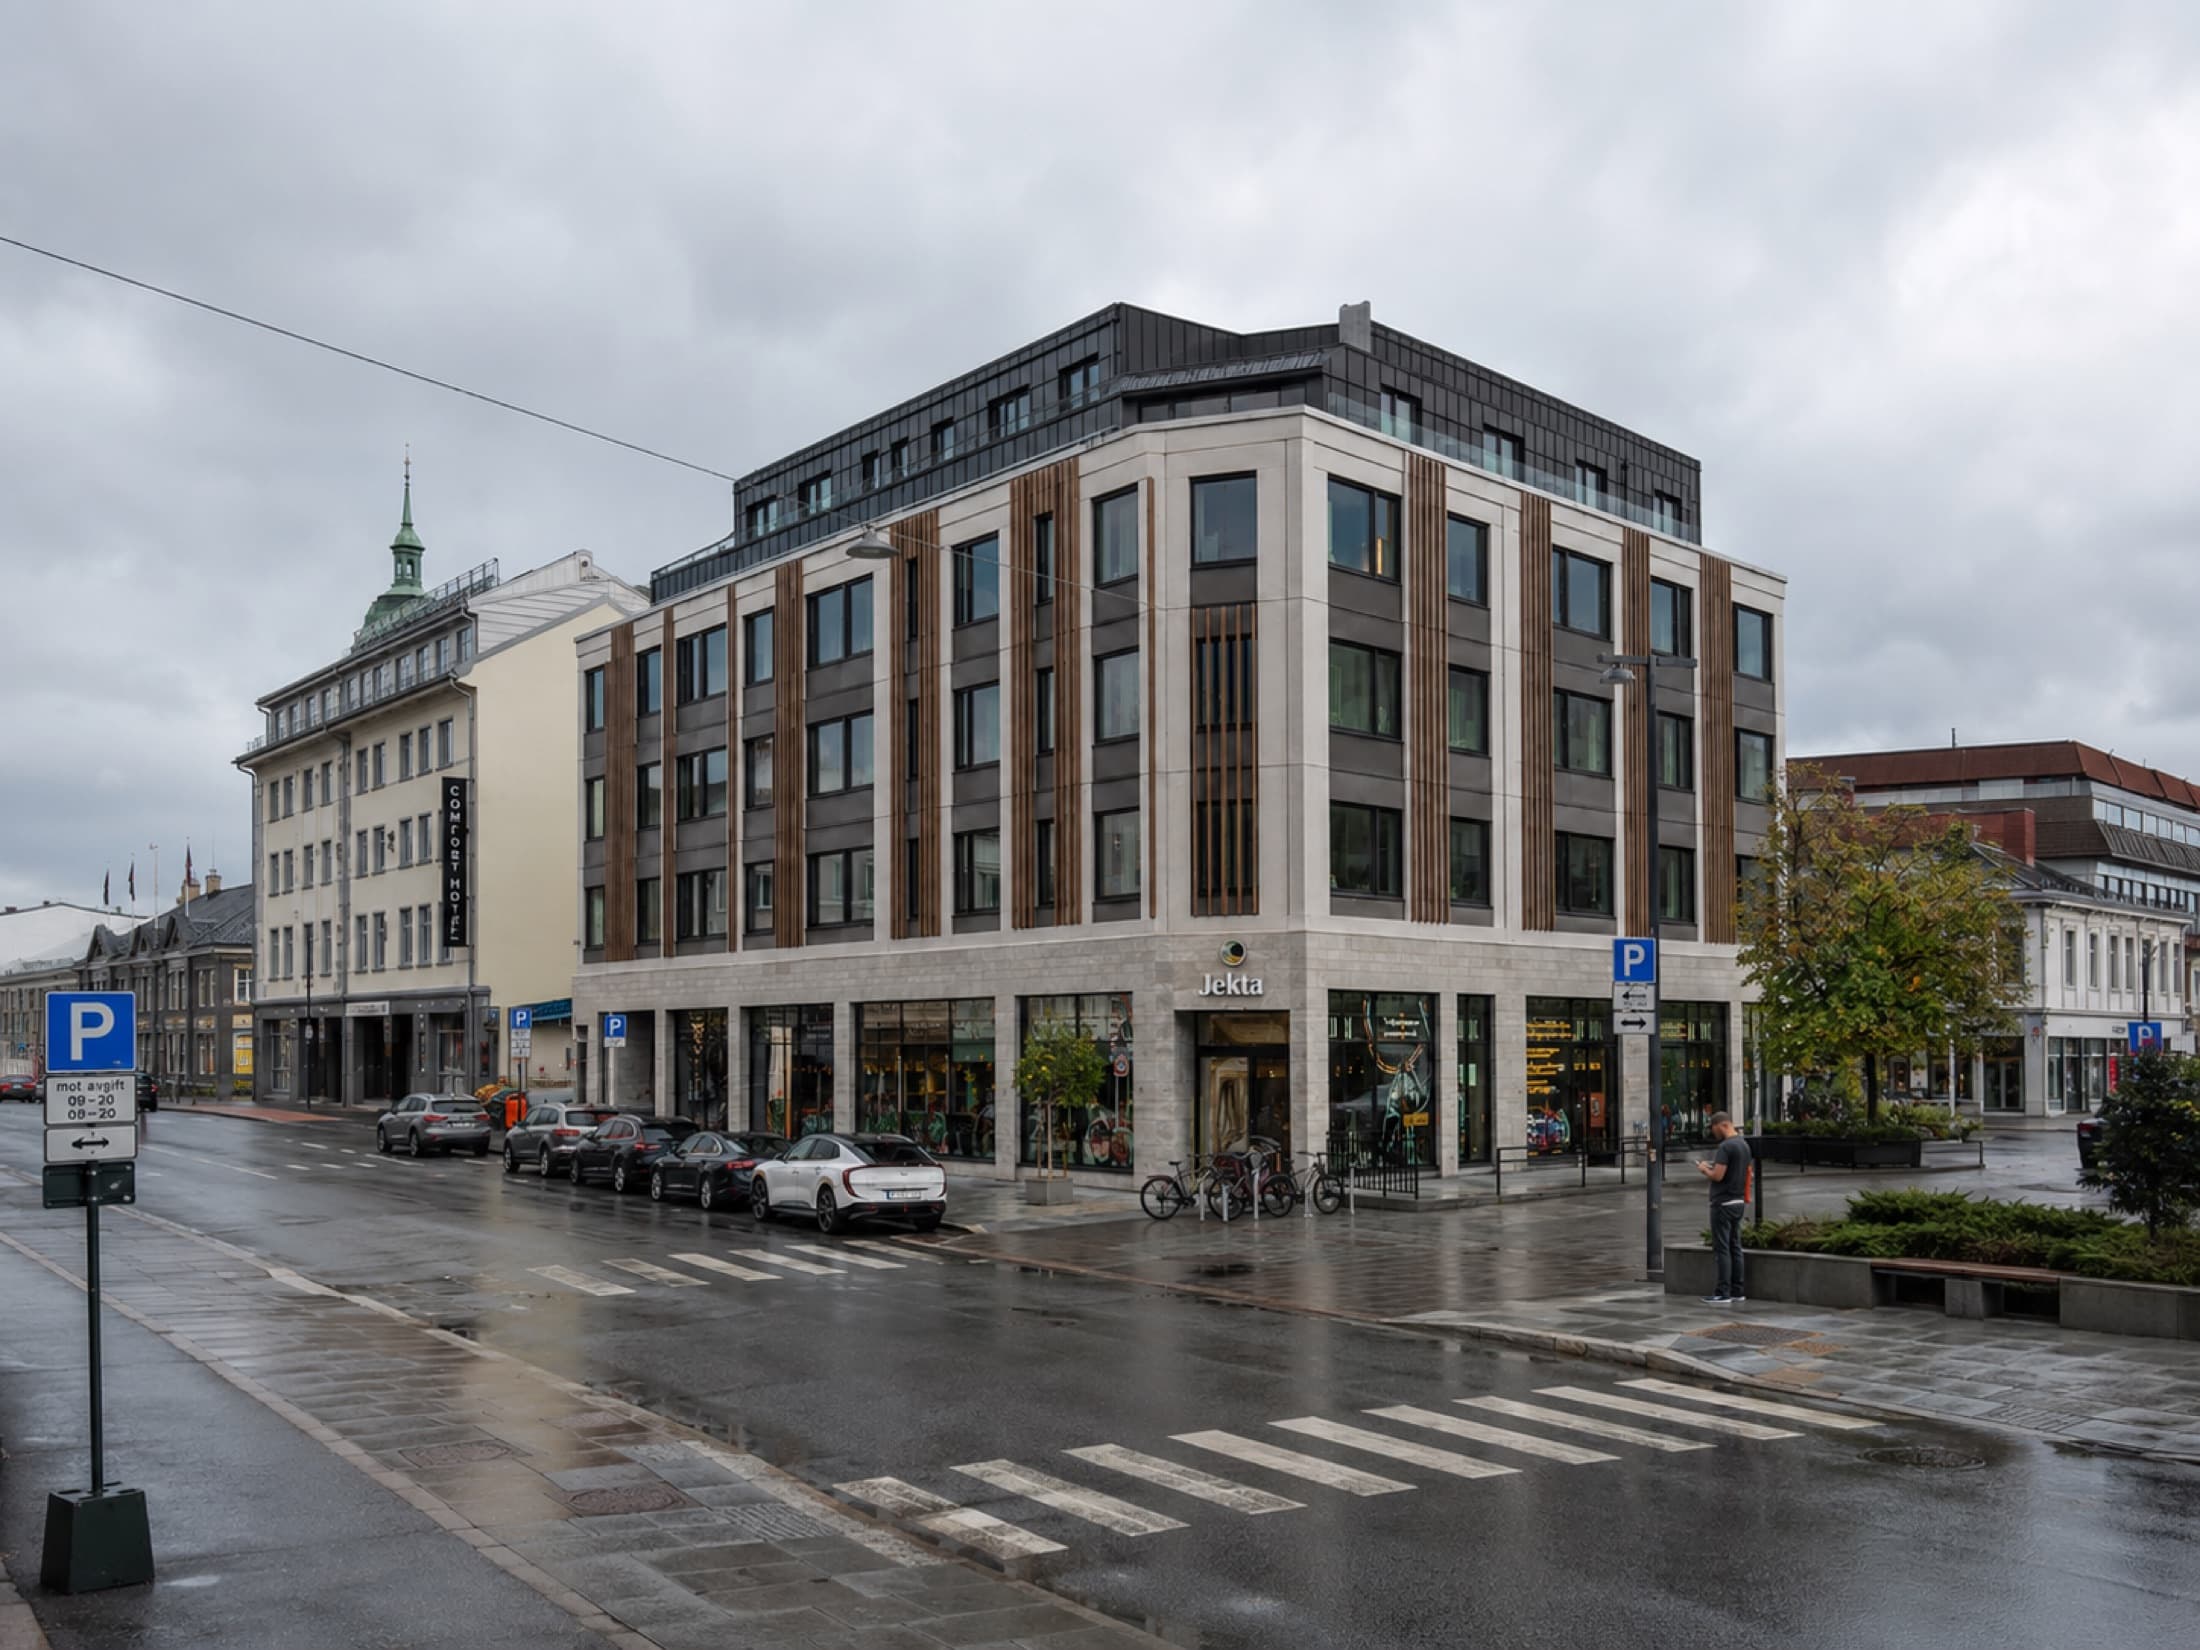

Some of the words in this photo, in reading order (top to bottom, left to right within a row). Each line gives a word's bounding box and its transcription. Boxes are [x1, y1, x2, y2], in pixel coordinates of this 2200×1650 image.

[1623, 943, 1645, 977] P
[1199, 972, 1264, 996] Jekta
[516, 1011, 527, 1027] P
[609, 1018, 622, 1036] P
[71, 1002, 115, 1061] P
[2137, 1025, 2154, 1047] P
[56, 1081, 81, 1092] mot
[88, 1079, 125, 1093] avgift
